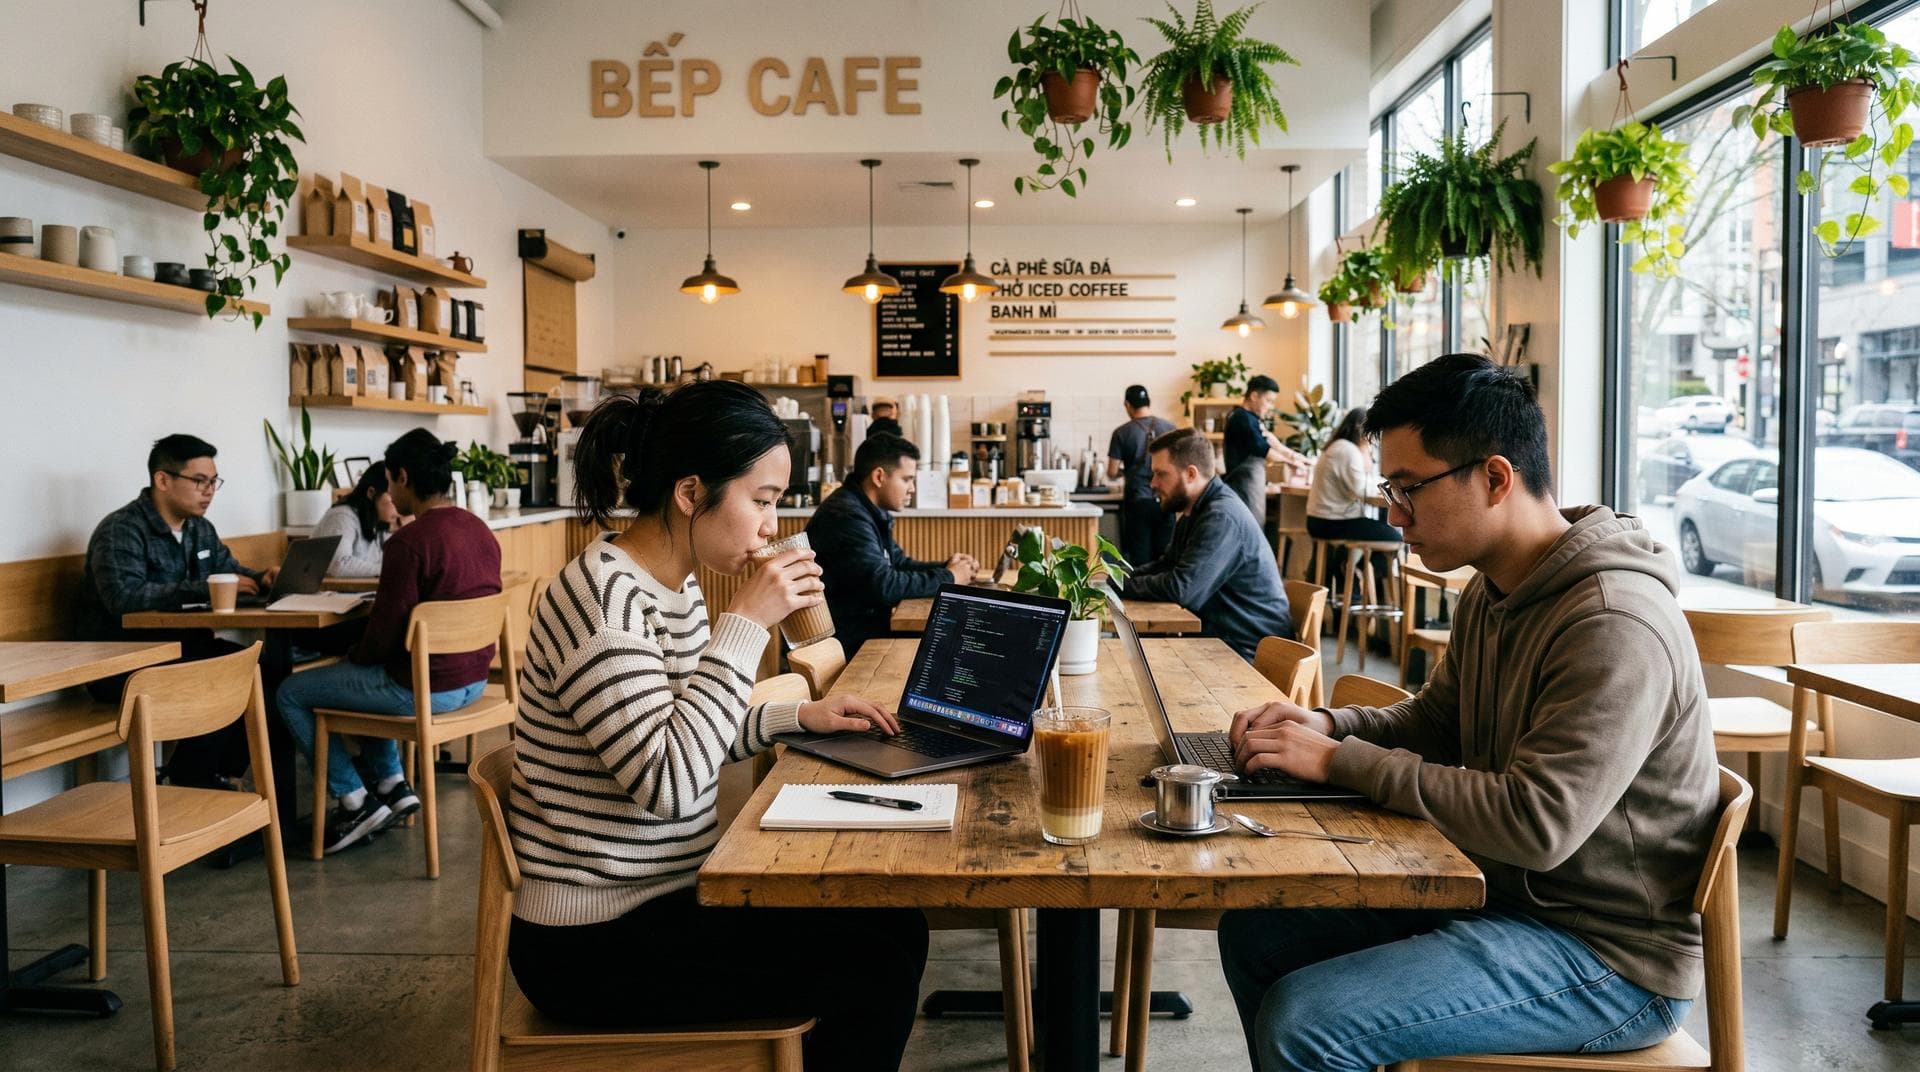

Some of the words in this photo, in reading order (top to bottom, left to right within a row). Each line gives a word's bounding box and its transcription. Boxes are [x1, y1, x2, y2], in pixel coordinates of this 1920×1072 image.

[590, 32, 722, 118] BẾP
[747, 56, 922, 117] CAFE
[990, 258, 1012, 275] CÀ
[1017, 258, 1048, 275] PHÊ
[1053, 257, 1085, 275] SỮA
[1090, 257, 1112, 275] ĐÁ
[991, 278, 1024, 297] HỞ
[1028, 283, 1064, 297] ICED
[1069, 282, 1129, 297] COFFEE
[991, 305, 1034, 319] BANH
[1039, 300, 1057, 319] MÌ
